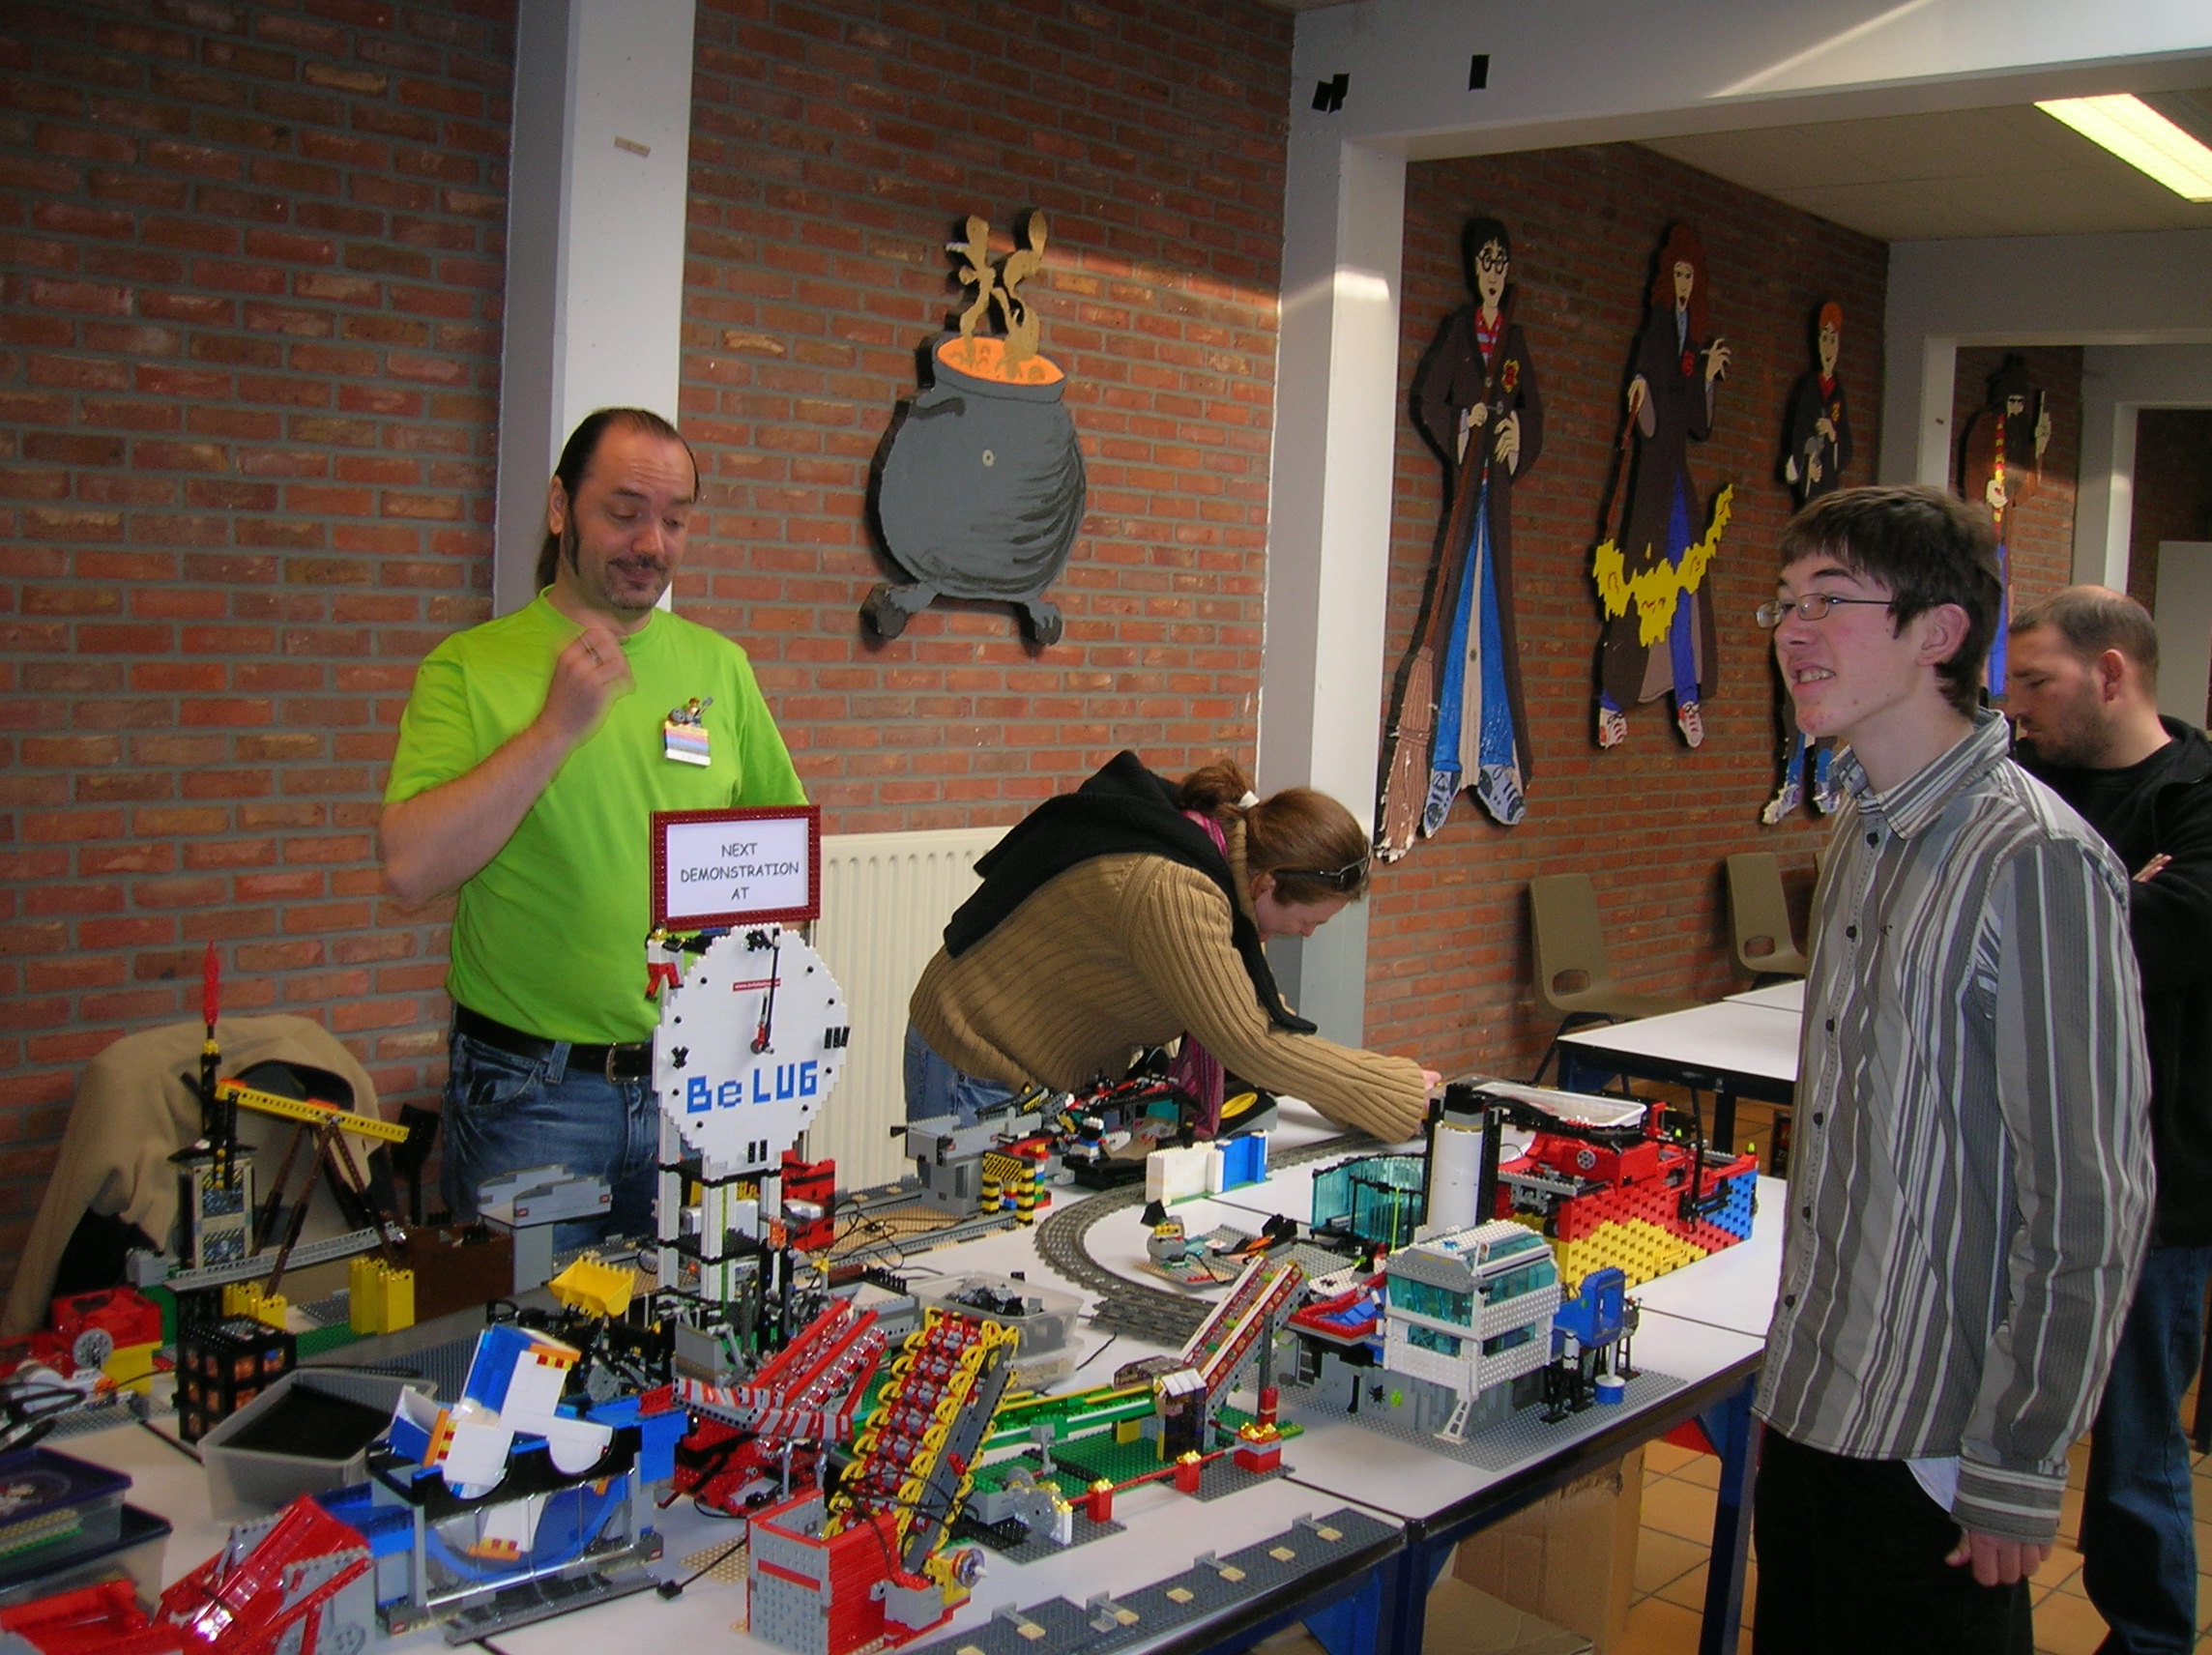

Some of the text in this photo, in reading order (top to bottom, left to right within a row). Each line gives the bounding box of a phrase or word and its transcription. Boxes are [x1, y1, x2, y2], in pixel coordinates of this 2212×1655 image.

[721, 842, 758, 857] NEXT
[680, 861, 800, 883] DEMONSTRATION
[731, 886, 750, 901] AT
